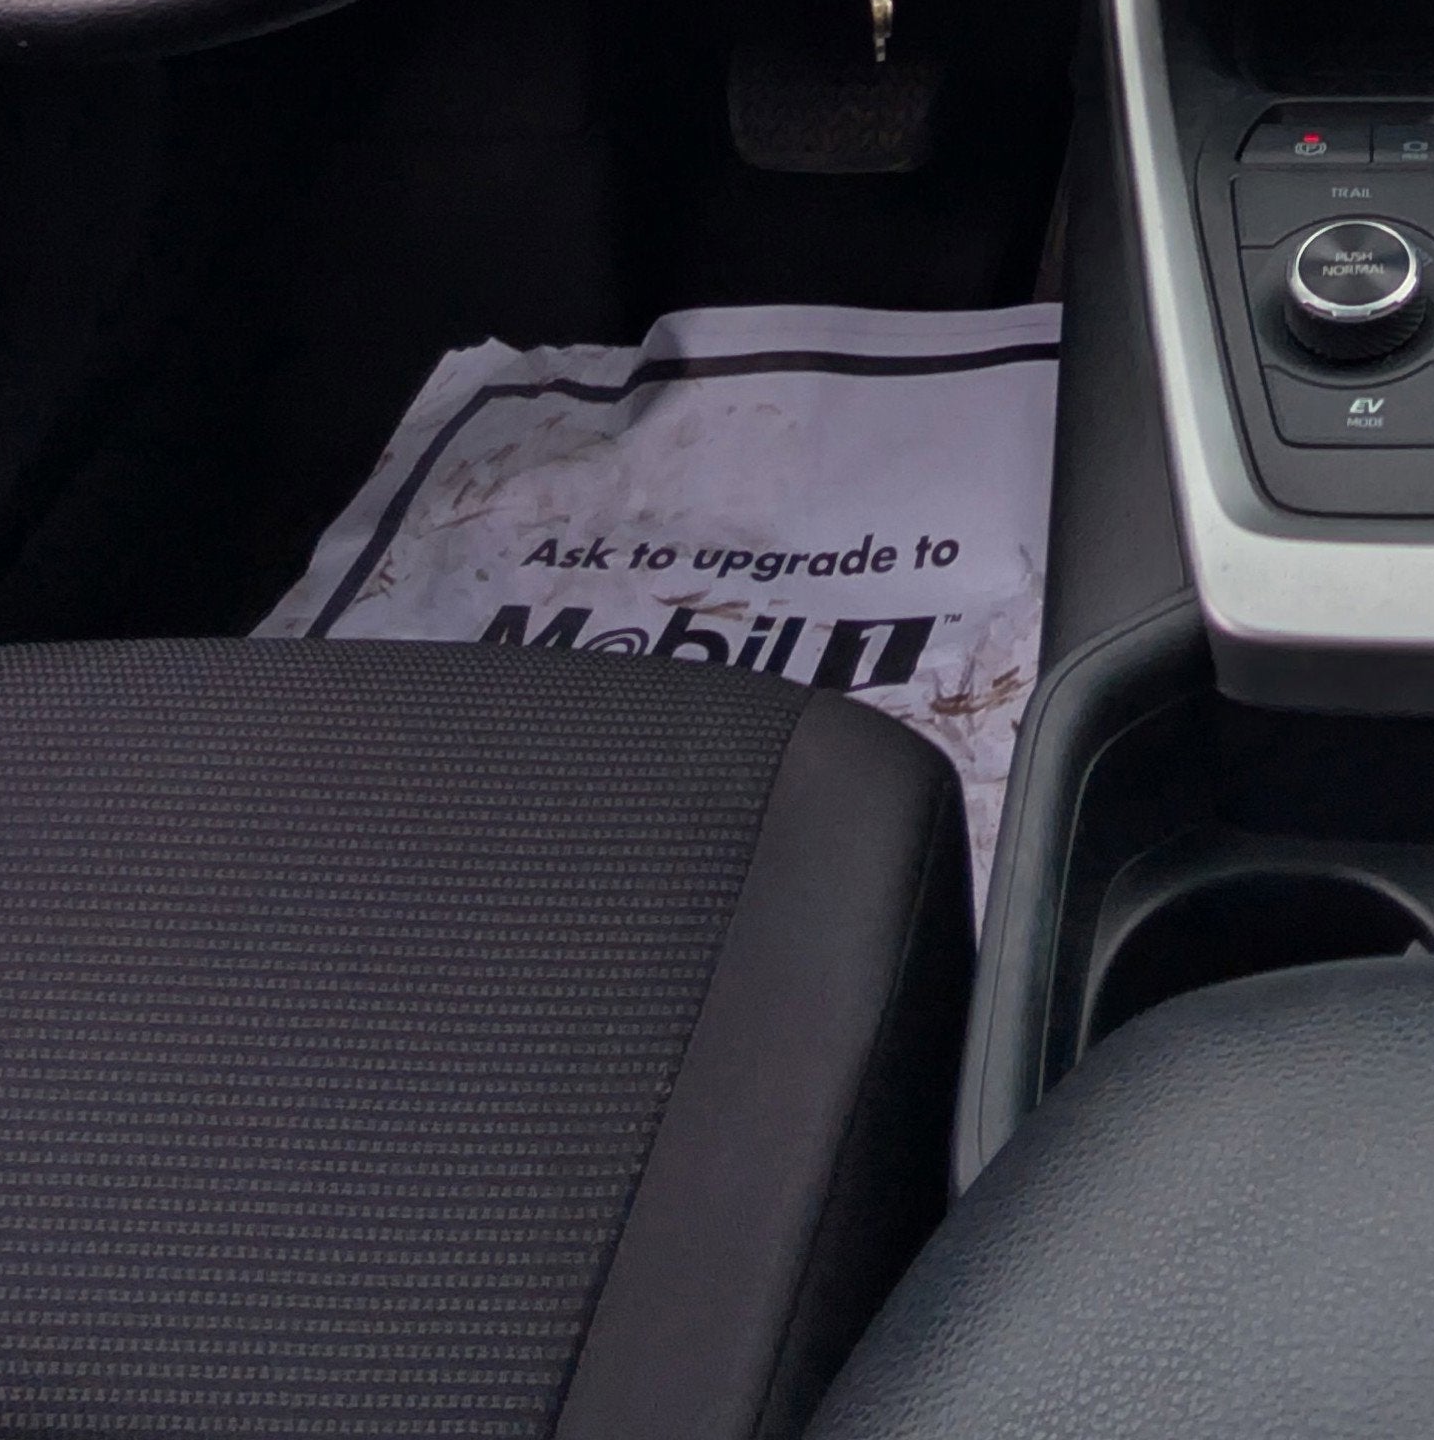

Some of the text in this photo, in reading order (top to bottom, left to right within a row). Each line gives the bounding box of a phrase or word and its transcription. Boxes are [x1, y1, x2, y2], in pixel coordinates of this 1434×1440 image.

[1331, 187, 1374, 199] TRAIL
[1335, 251, 1374, 263] PUSH
[1321, 262, 1386, 278] NORMAL
[1349, 397, 1386, 414] EV
[1346, 416, 1385, 428] MODE
[520, 533, 961, 583] Ask to upgrade to
